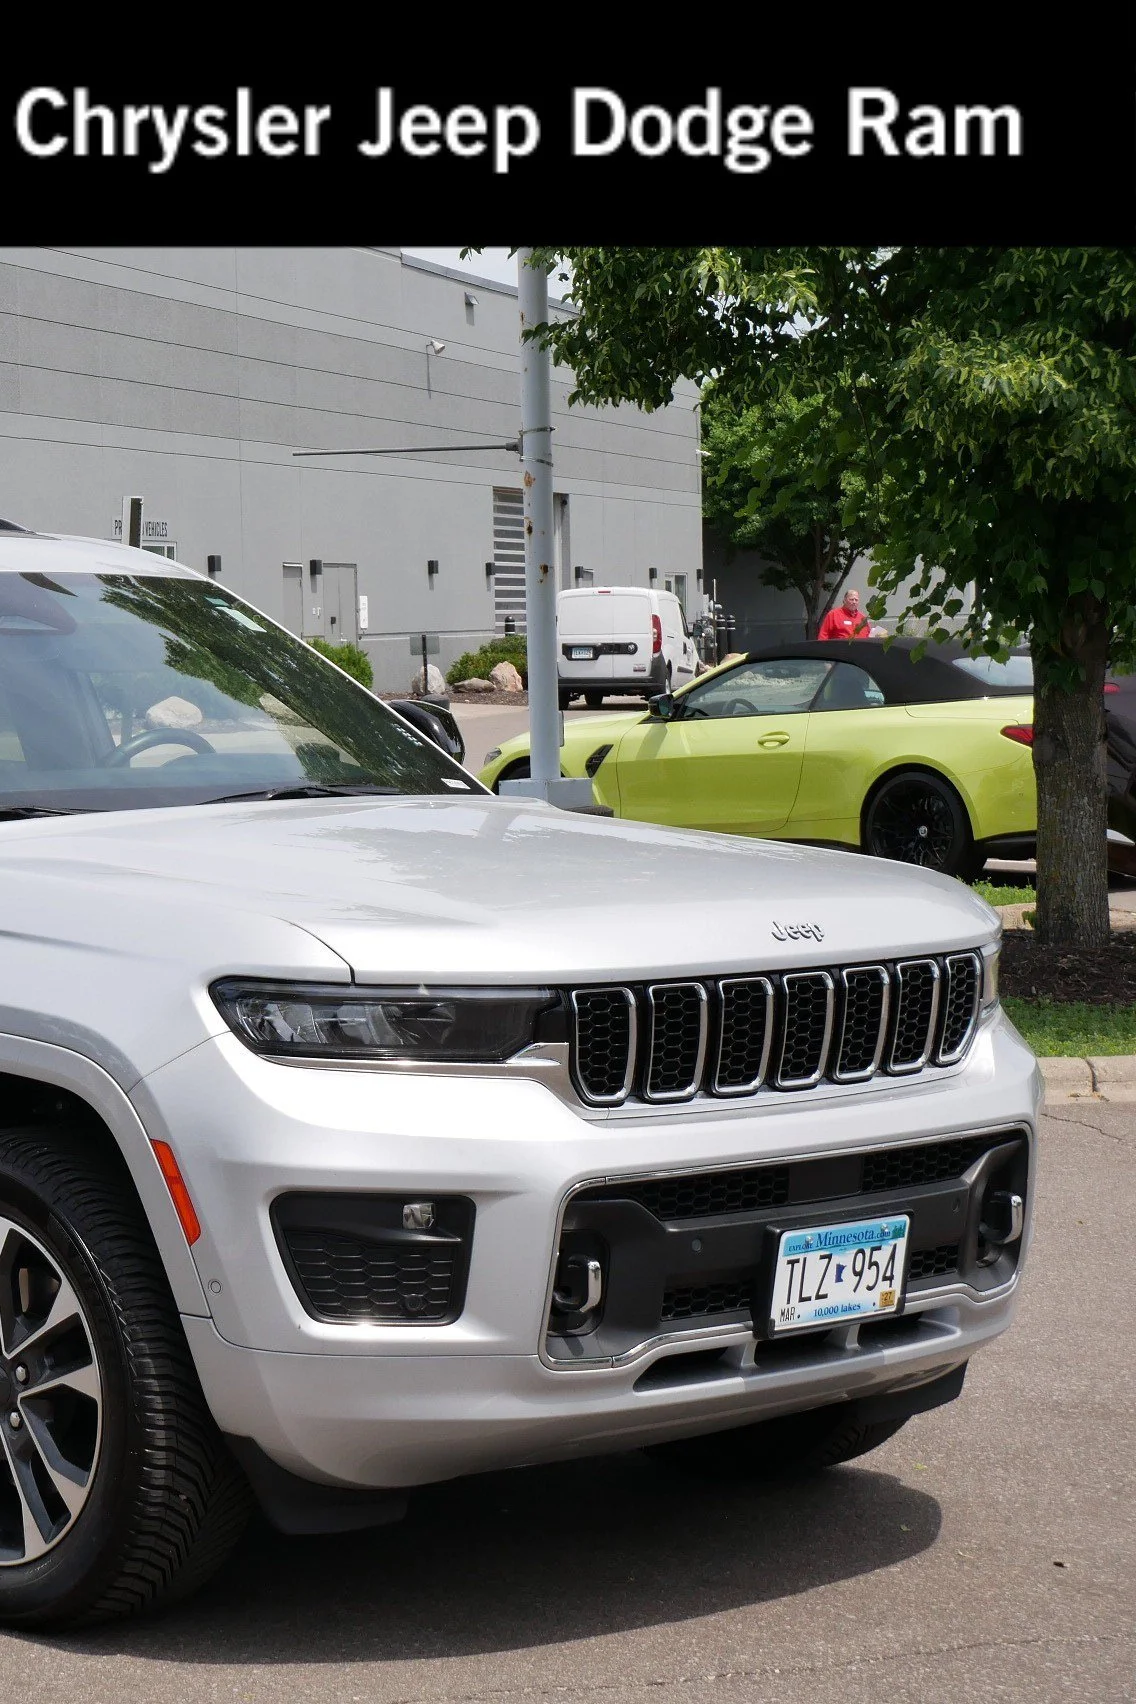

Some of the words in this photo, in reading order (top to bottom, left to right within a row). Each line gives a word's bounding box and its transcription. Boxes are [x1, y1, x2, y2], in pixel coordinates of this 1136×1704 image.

[145, 521, 168, 537] VEHICLES
[771, 920, 825, 943] Jeep
[786, 1253, 833, 1305] TLZ
[852, 1243, 898, 1293] 954
[883, 1292, 893, 1301] 27
[779, 1306, 796, 1323] MAR
[813, 1305, 839, 1318] 10,000
[840, 1303, 861, 1316] lakes
